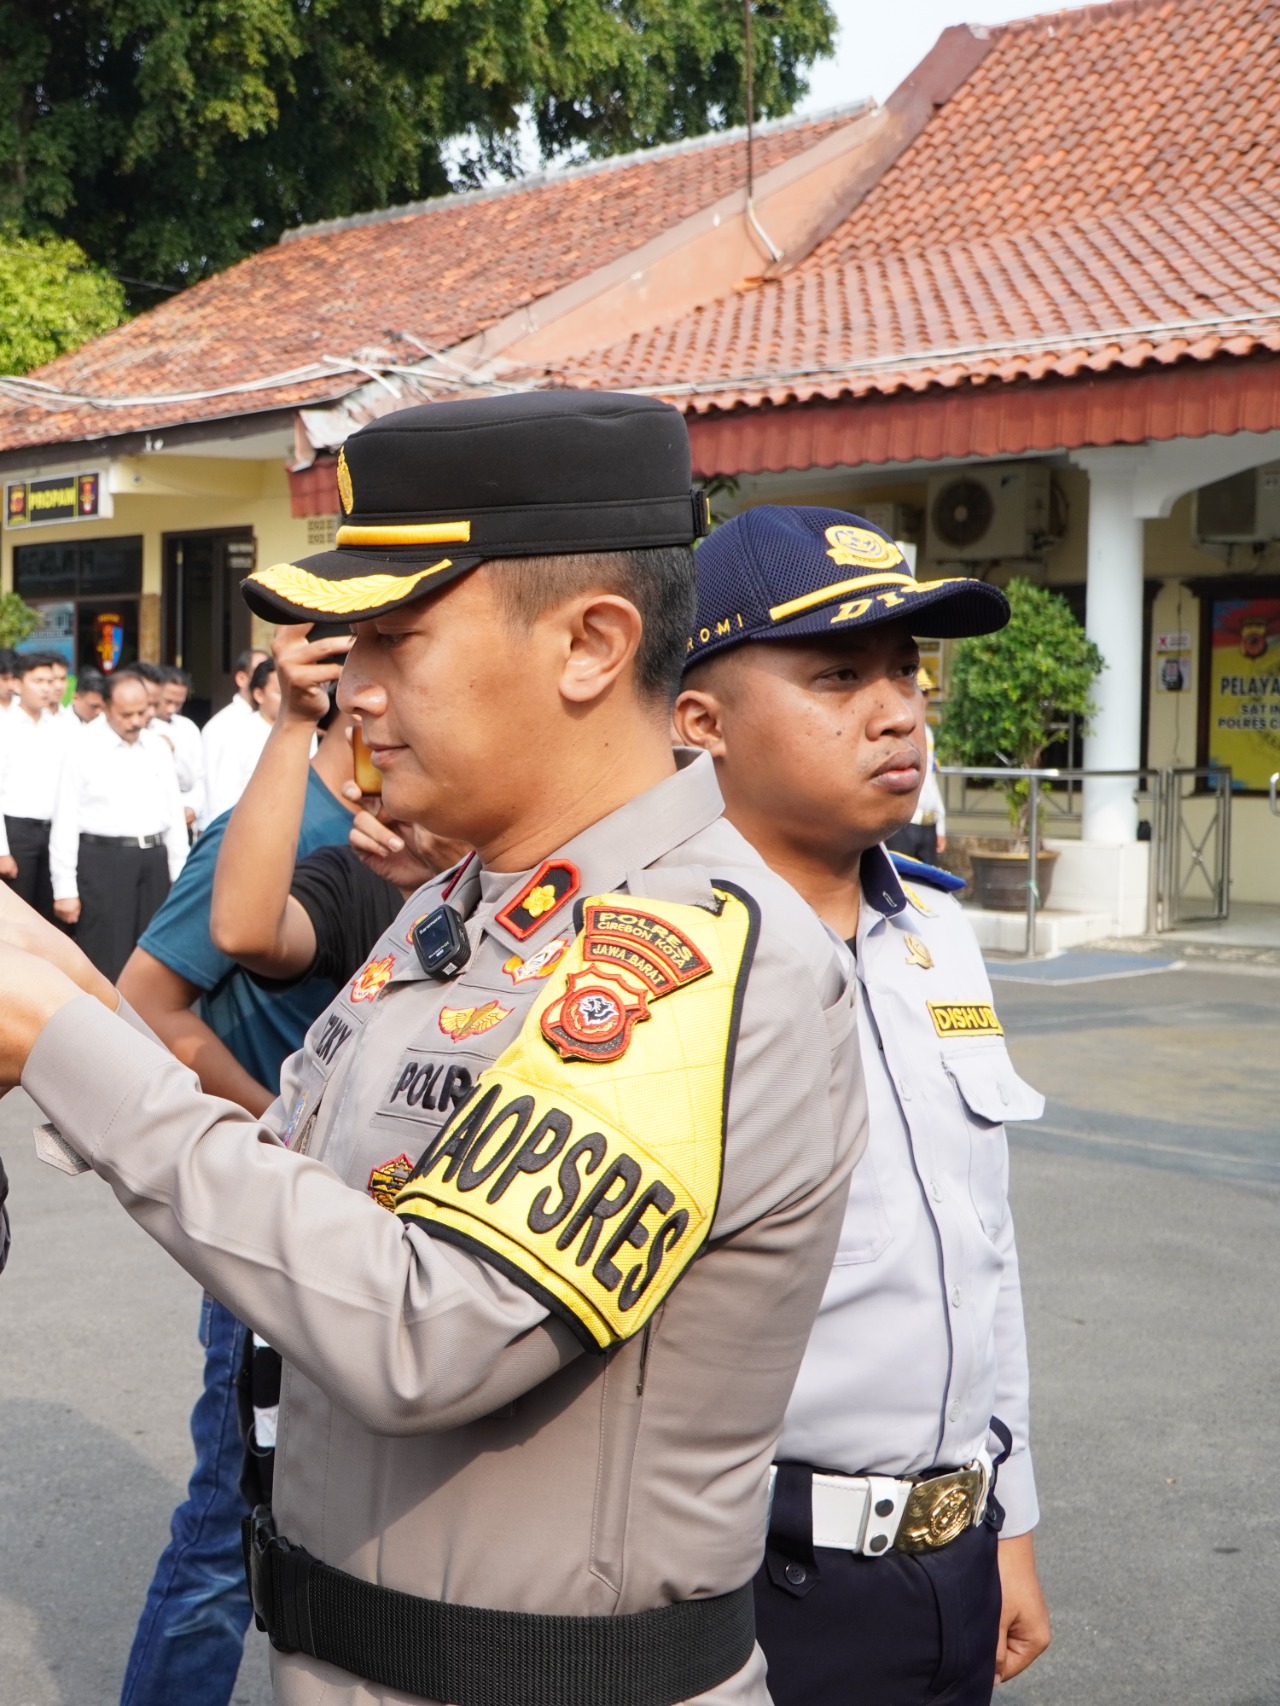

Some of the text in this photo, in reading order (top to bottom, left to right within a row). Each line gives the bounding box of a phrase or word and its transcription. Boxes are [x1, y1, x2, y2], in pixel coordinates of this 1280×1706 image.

[597, 921, 686, 969] CIREBON KOTA
[599, 912, 693, 963] POLRES
[592, 943, 666, 985] JAWA BARAT
[934, 1007, 998, 1031] DISHUB
[389, 1061, 473, 1112] POLR
[406, 1083, 689, 1312] AOPSRES
